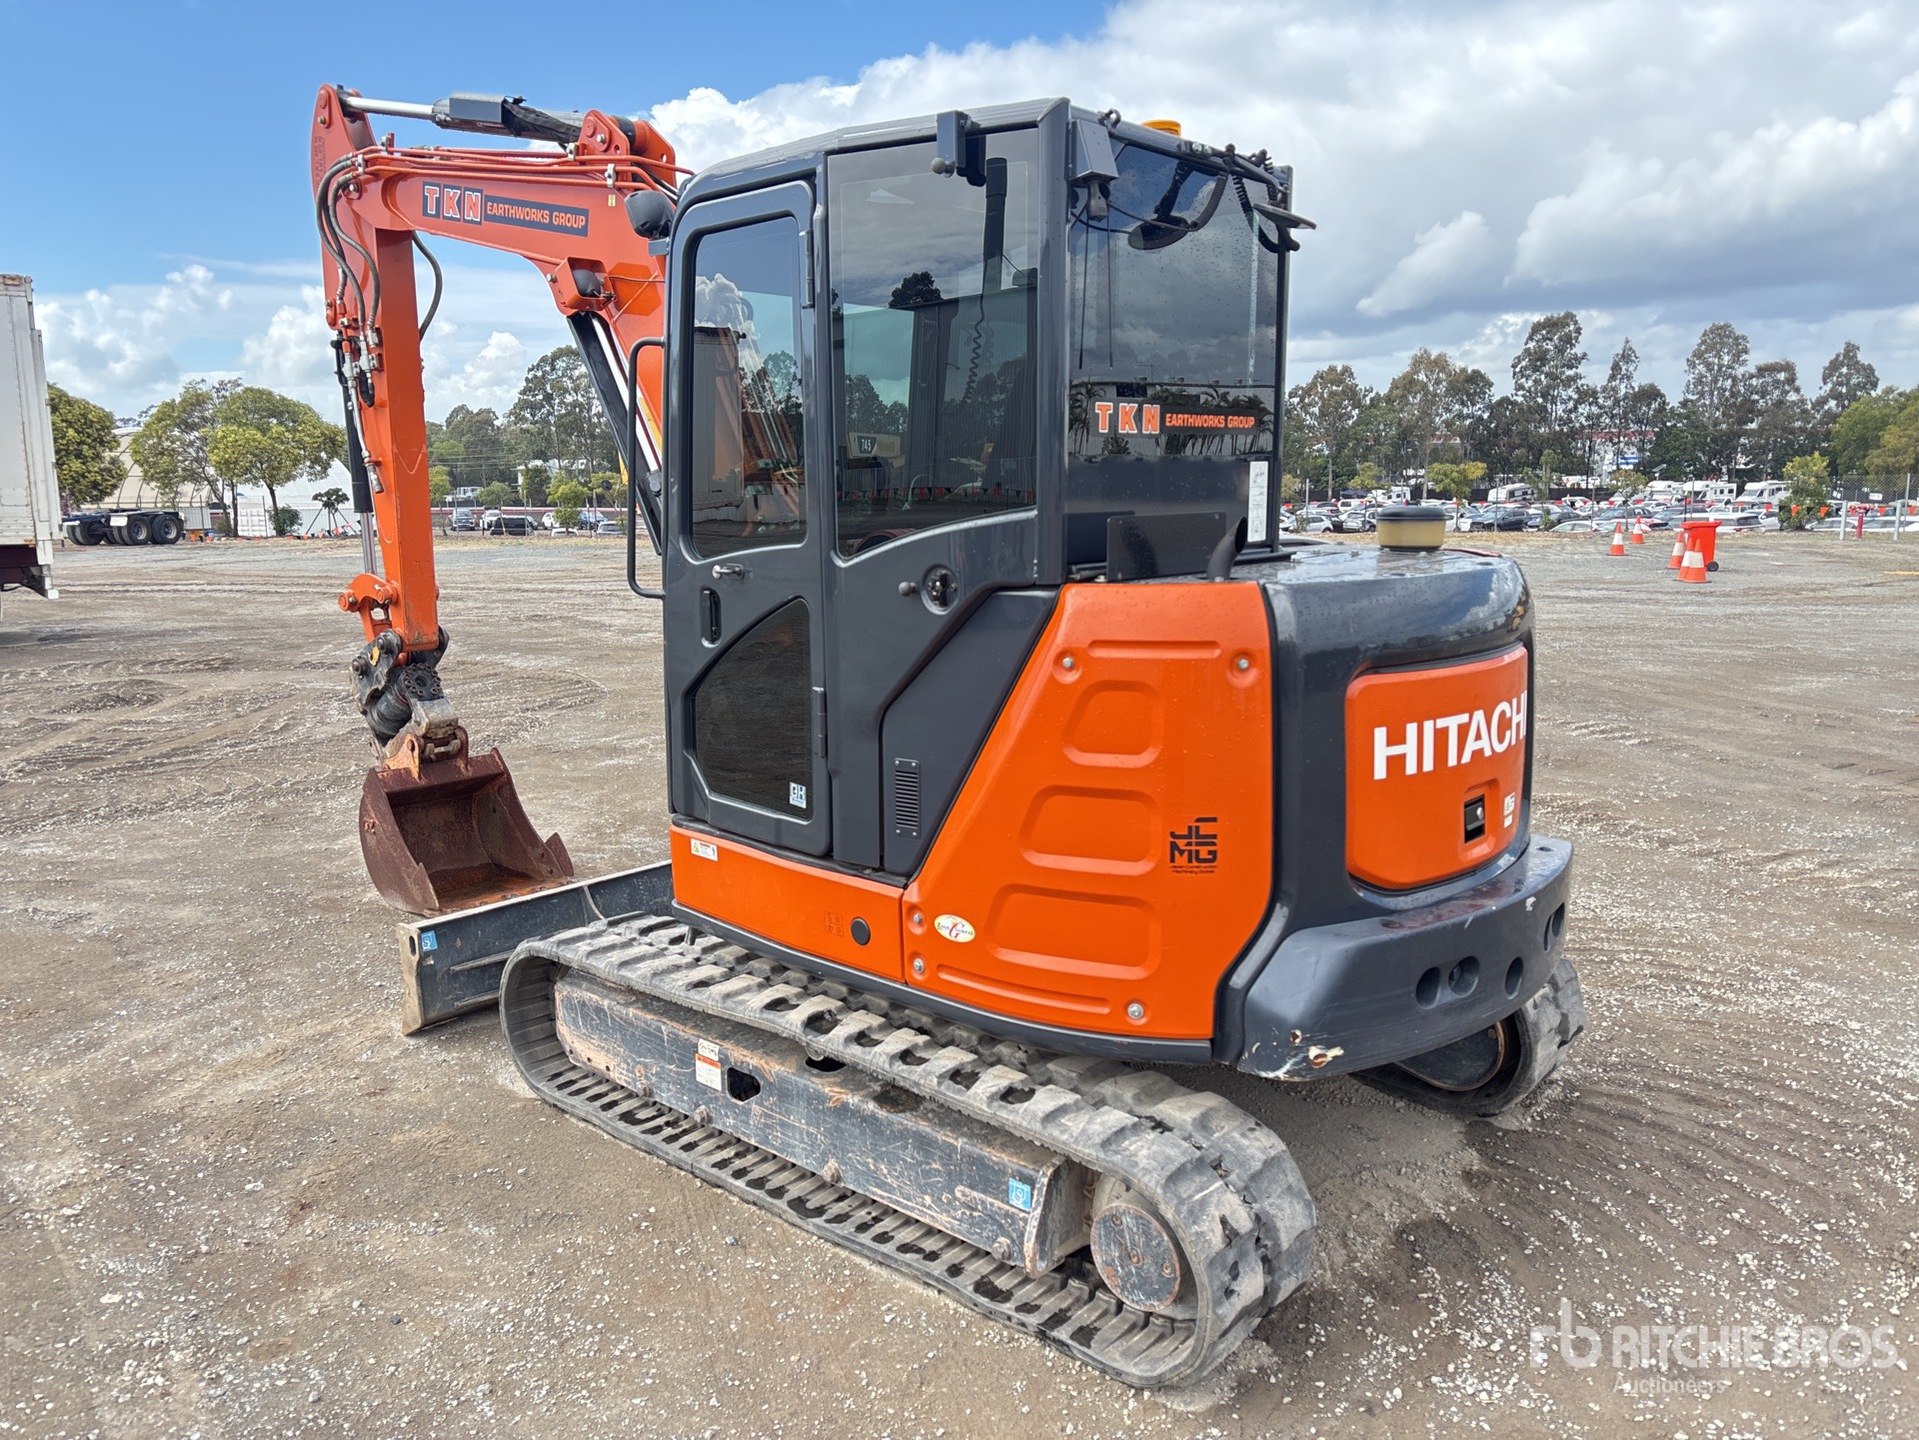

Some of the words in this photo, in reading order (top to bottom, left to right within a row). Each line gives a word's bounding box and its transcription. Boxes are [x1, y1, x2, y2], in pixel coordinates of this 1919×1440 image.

[424, 185, 481, 222] TKN
[487, 201, 550, 224] EARTHWORKS
[552, 211, 586, 229] GROUP
[1095, 402, 1161, 434] TKN
[1165, 413, 1226, 428] EARTHWORKS
[1227, 415, 1256, 428] GROUP
[1373, 689, 1528, 780] HITACHI
